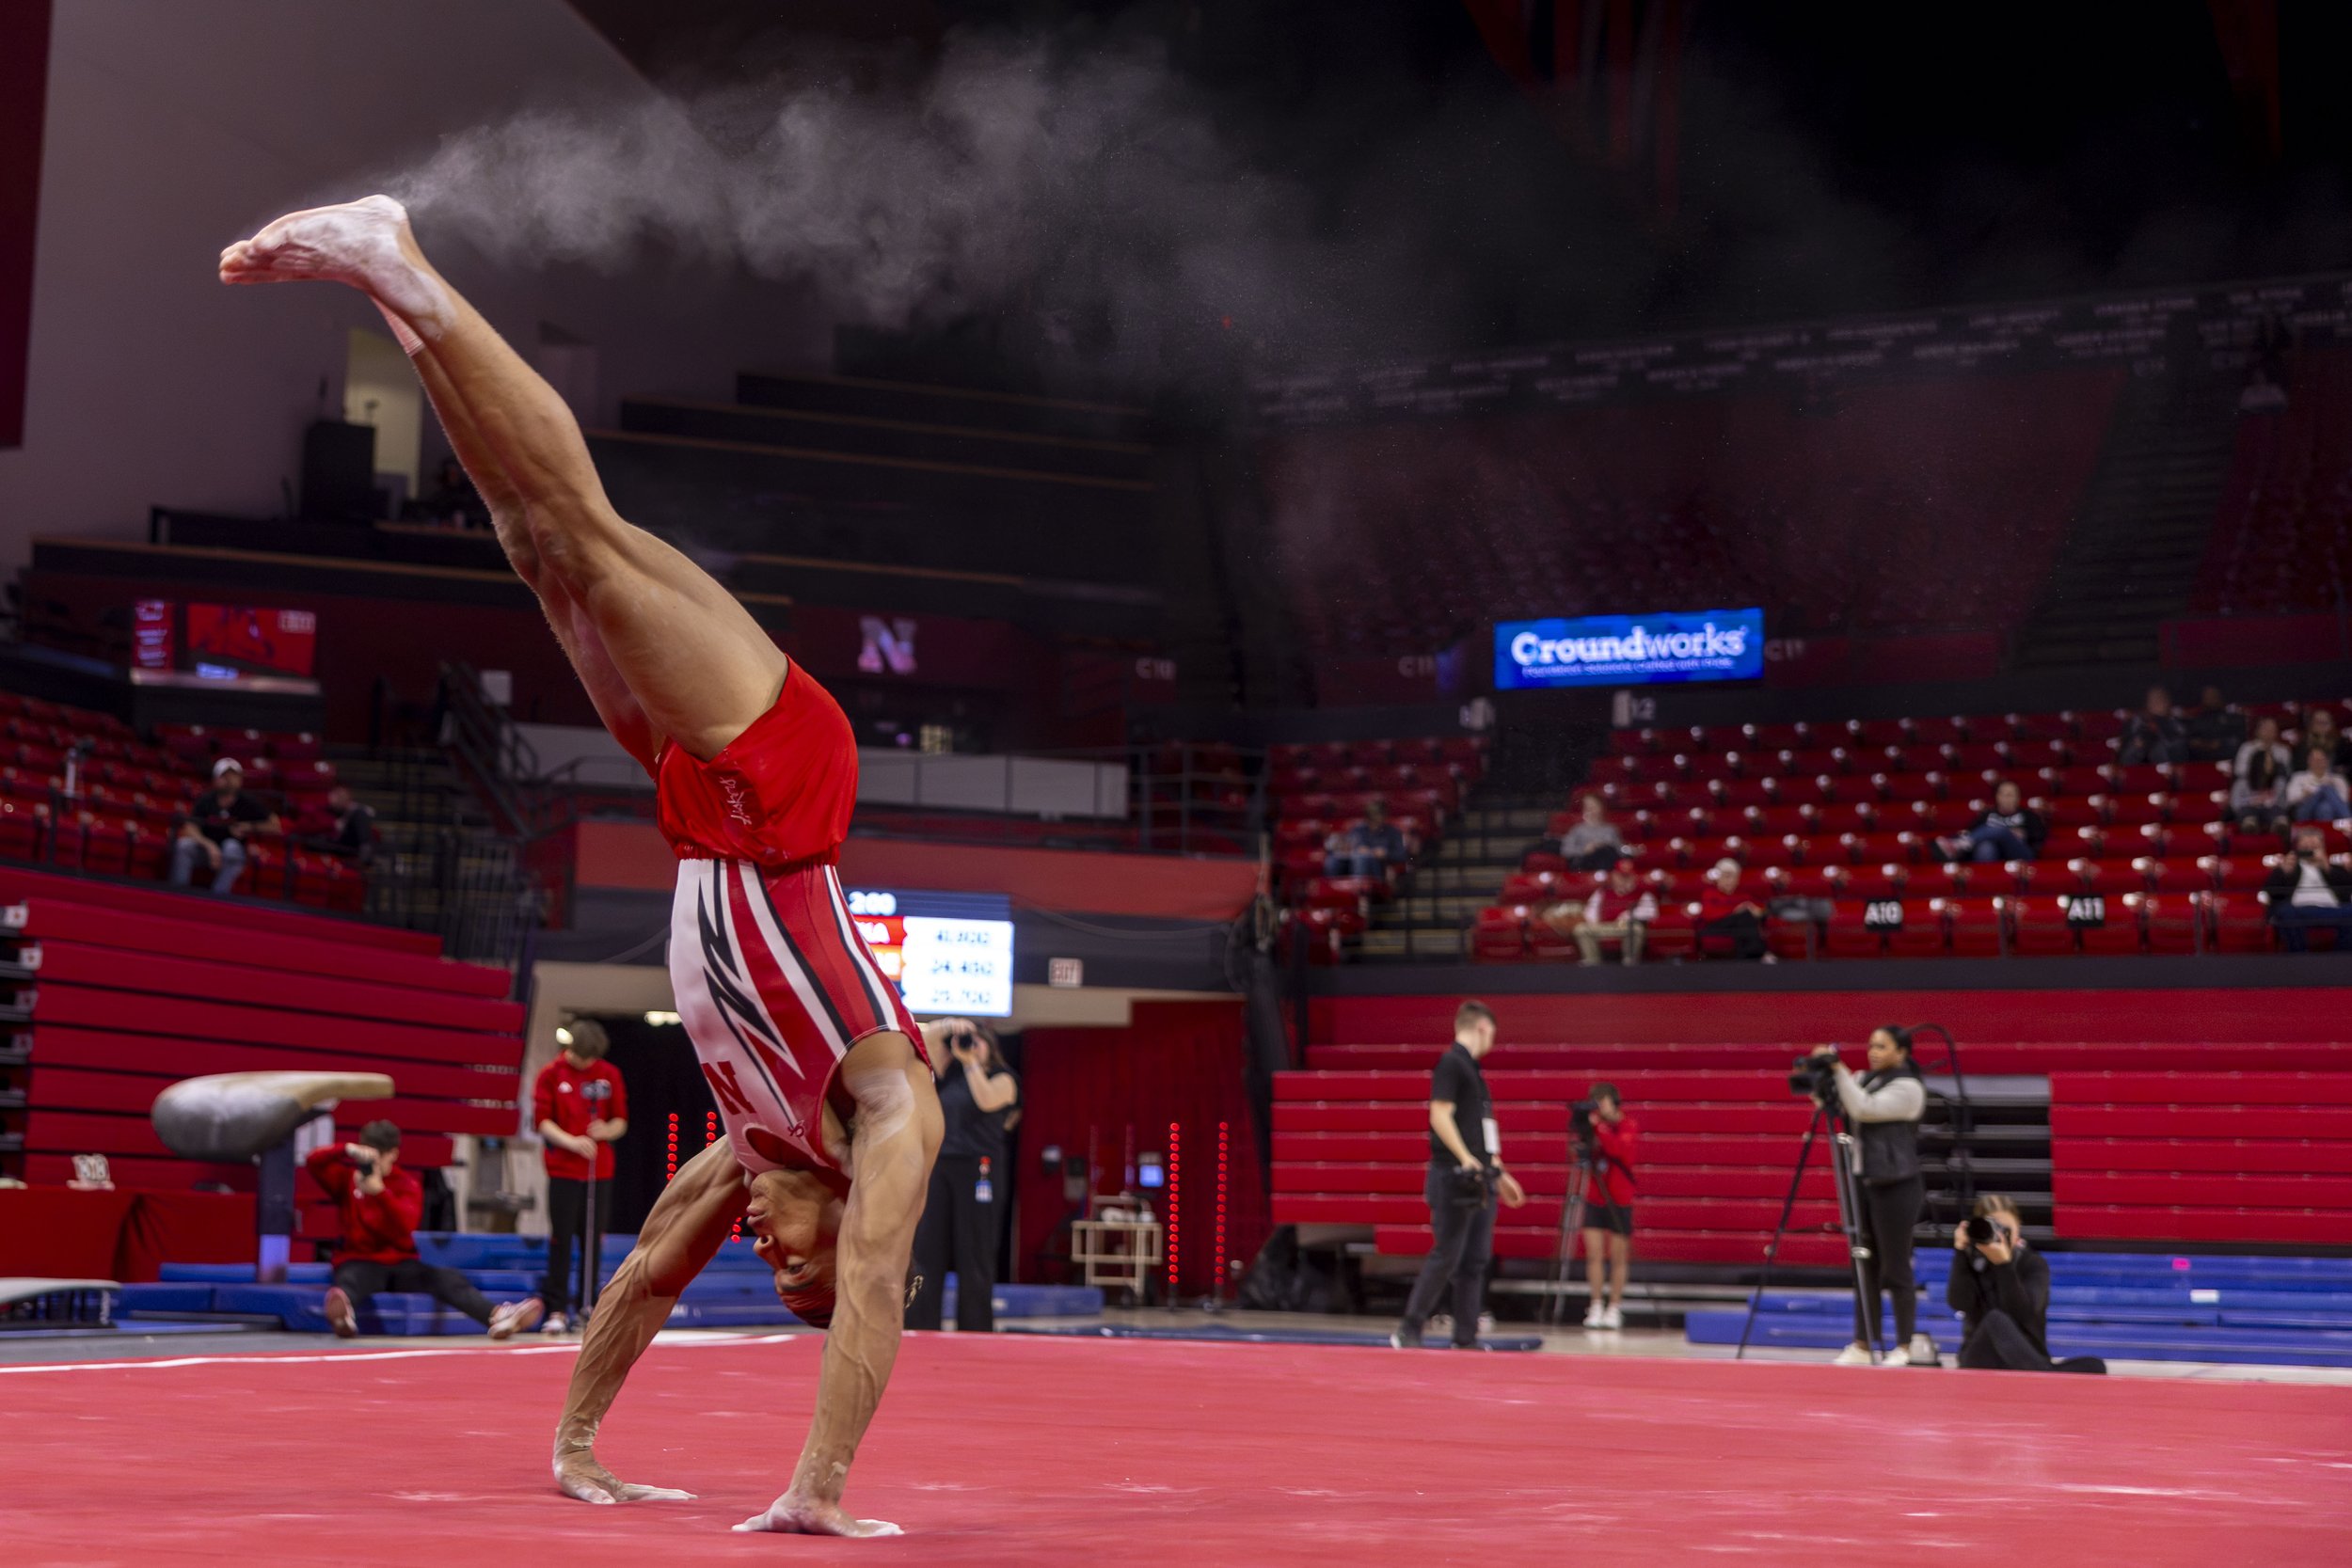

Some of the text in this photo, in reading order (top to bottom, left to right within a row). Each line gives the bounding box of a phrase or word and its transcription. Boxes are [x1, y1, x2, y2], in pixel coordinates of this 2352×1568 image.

[858, 617, 917, 673] N
[1864, 900, 1903, 925] A10
[2068, 896, 2105, 921] A11
[701, 1060, 756, 1115] N
